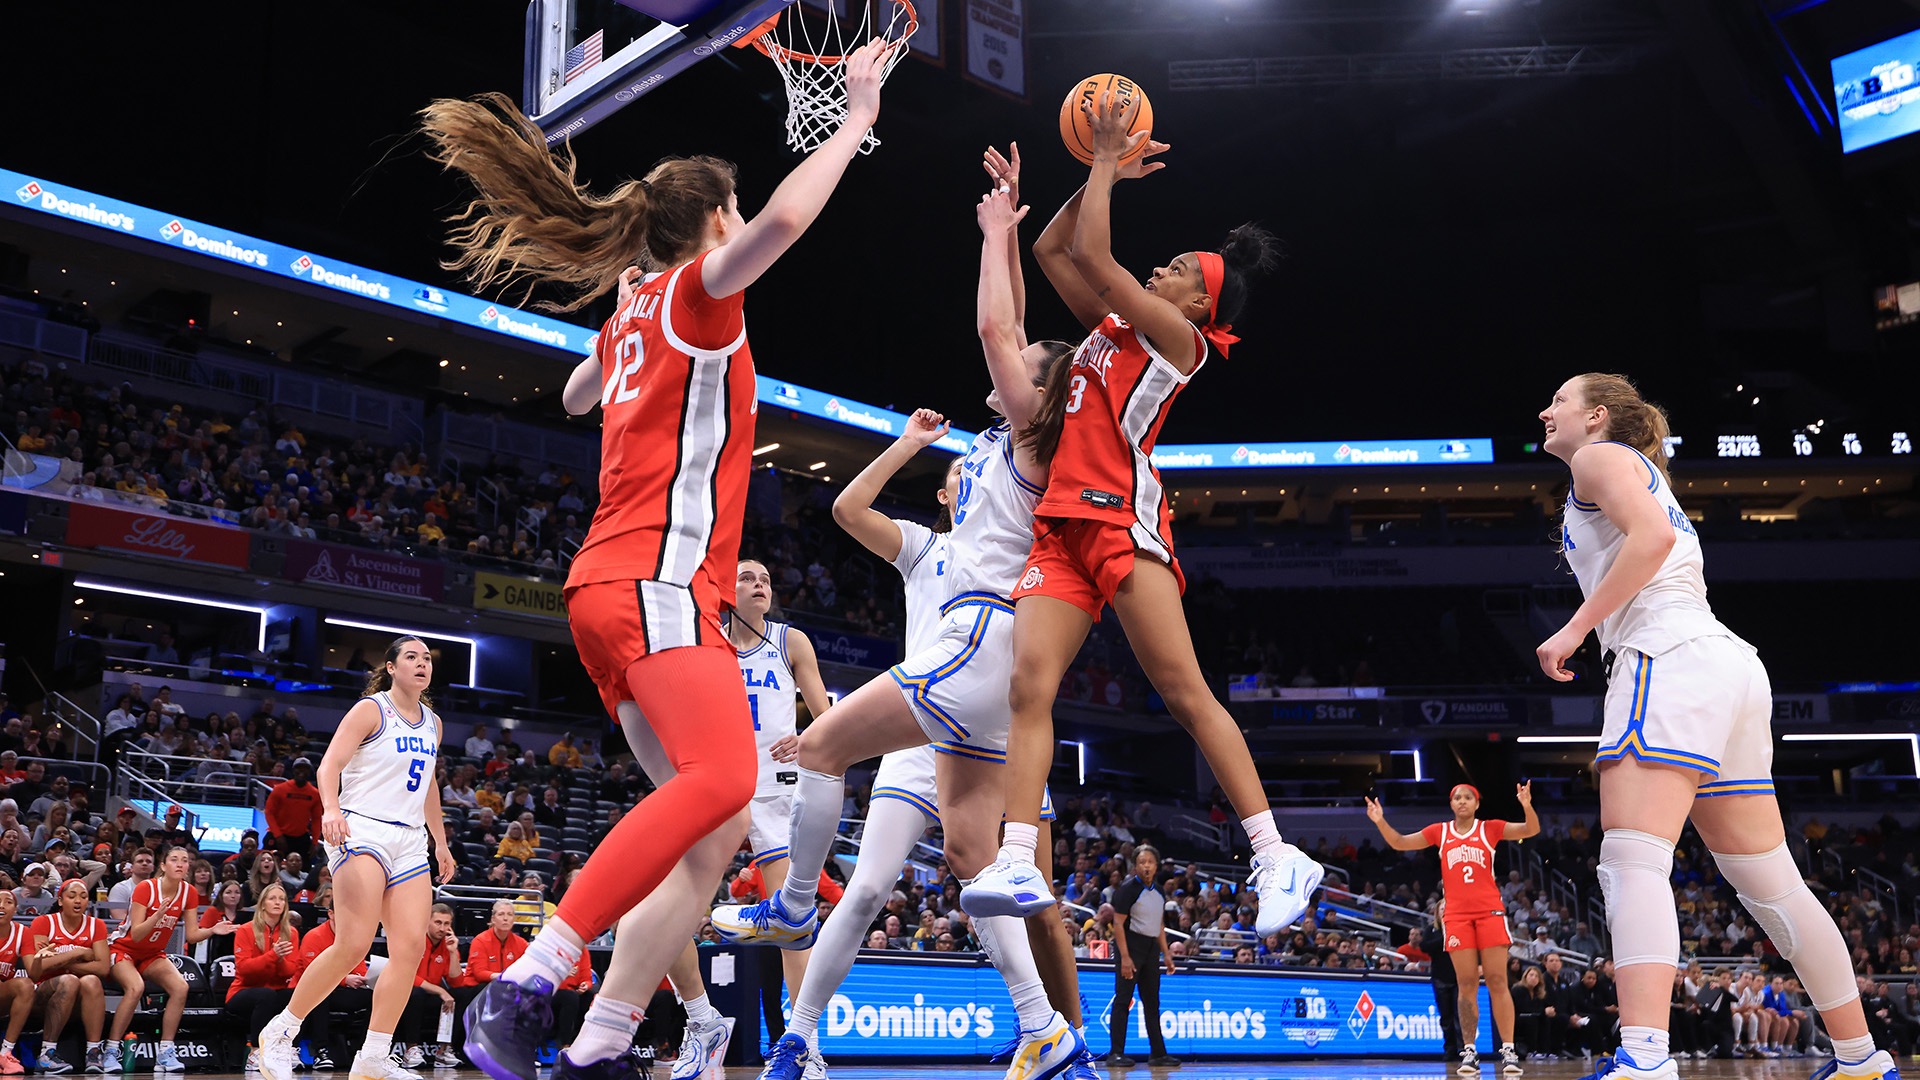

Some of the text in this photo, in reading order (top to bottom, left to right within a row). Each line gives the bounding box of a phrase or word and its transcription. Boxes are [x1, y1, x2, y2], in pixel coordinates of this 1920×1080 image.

[710, 24, 746, 50] Allstate
[630, 72, 664, 94] Allstate
[41, 191, 135, 231] Domino's
[183, 229, 268, 267] Domino's
[312, 264, 390, 300] Domino's
[497, 314, 567, 346] Domino's
[601, 330, 645, 406] 12
[1065, 375, 1088, 413] 3
[838, 405, 892, 432] Domino's
[1249, 449, 1316, 464] Domino's
[1351, 447, 1419, 463] Domino's
[1717, 442, 1760, 457] 23/52
[1793, 440, 1812, 455] 10
[1842, 439, 1862, 454] 16
[1892, 439, 1911, 454] 24
[963, 445, 990, 478] LA
[124, 514, 195, 556] Lilly
[346, 553, 422, 578] Ascension
[344, 570, 422, 596] St. Vincent
[831, 636, 869, 665] Kroger
[741, 668, 780, 691] LA
[1451, 702, 1509, 713] FANDUEL
[395, 736, 437, 757] UCLA
[406, 758, 426, 792] 5
[1462, 866, 1475, 883] 2
[149, 930, 162, 942] 8
[827, 993, 995, 1039] Domino's
[134, 1041, 213, 1059] Allate.
